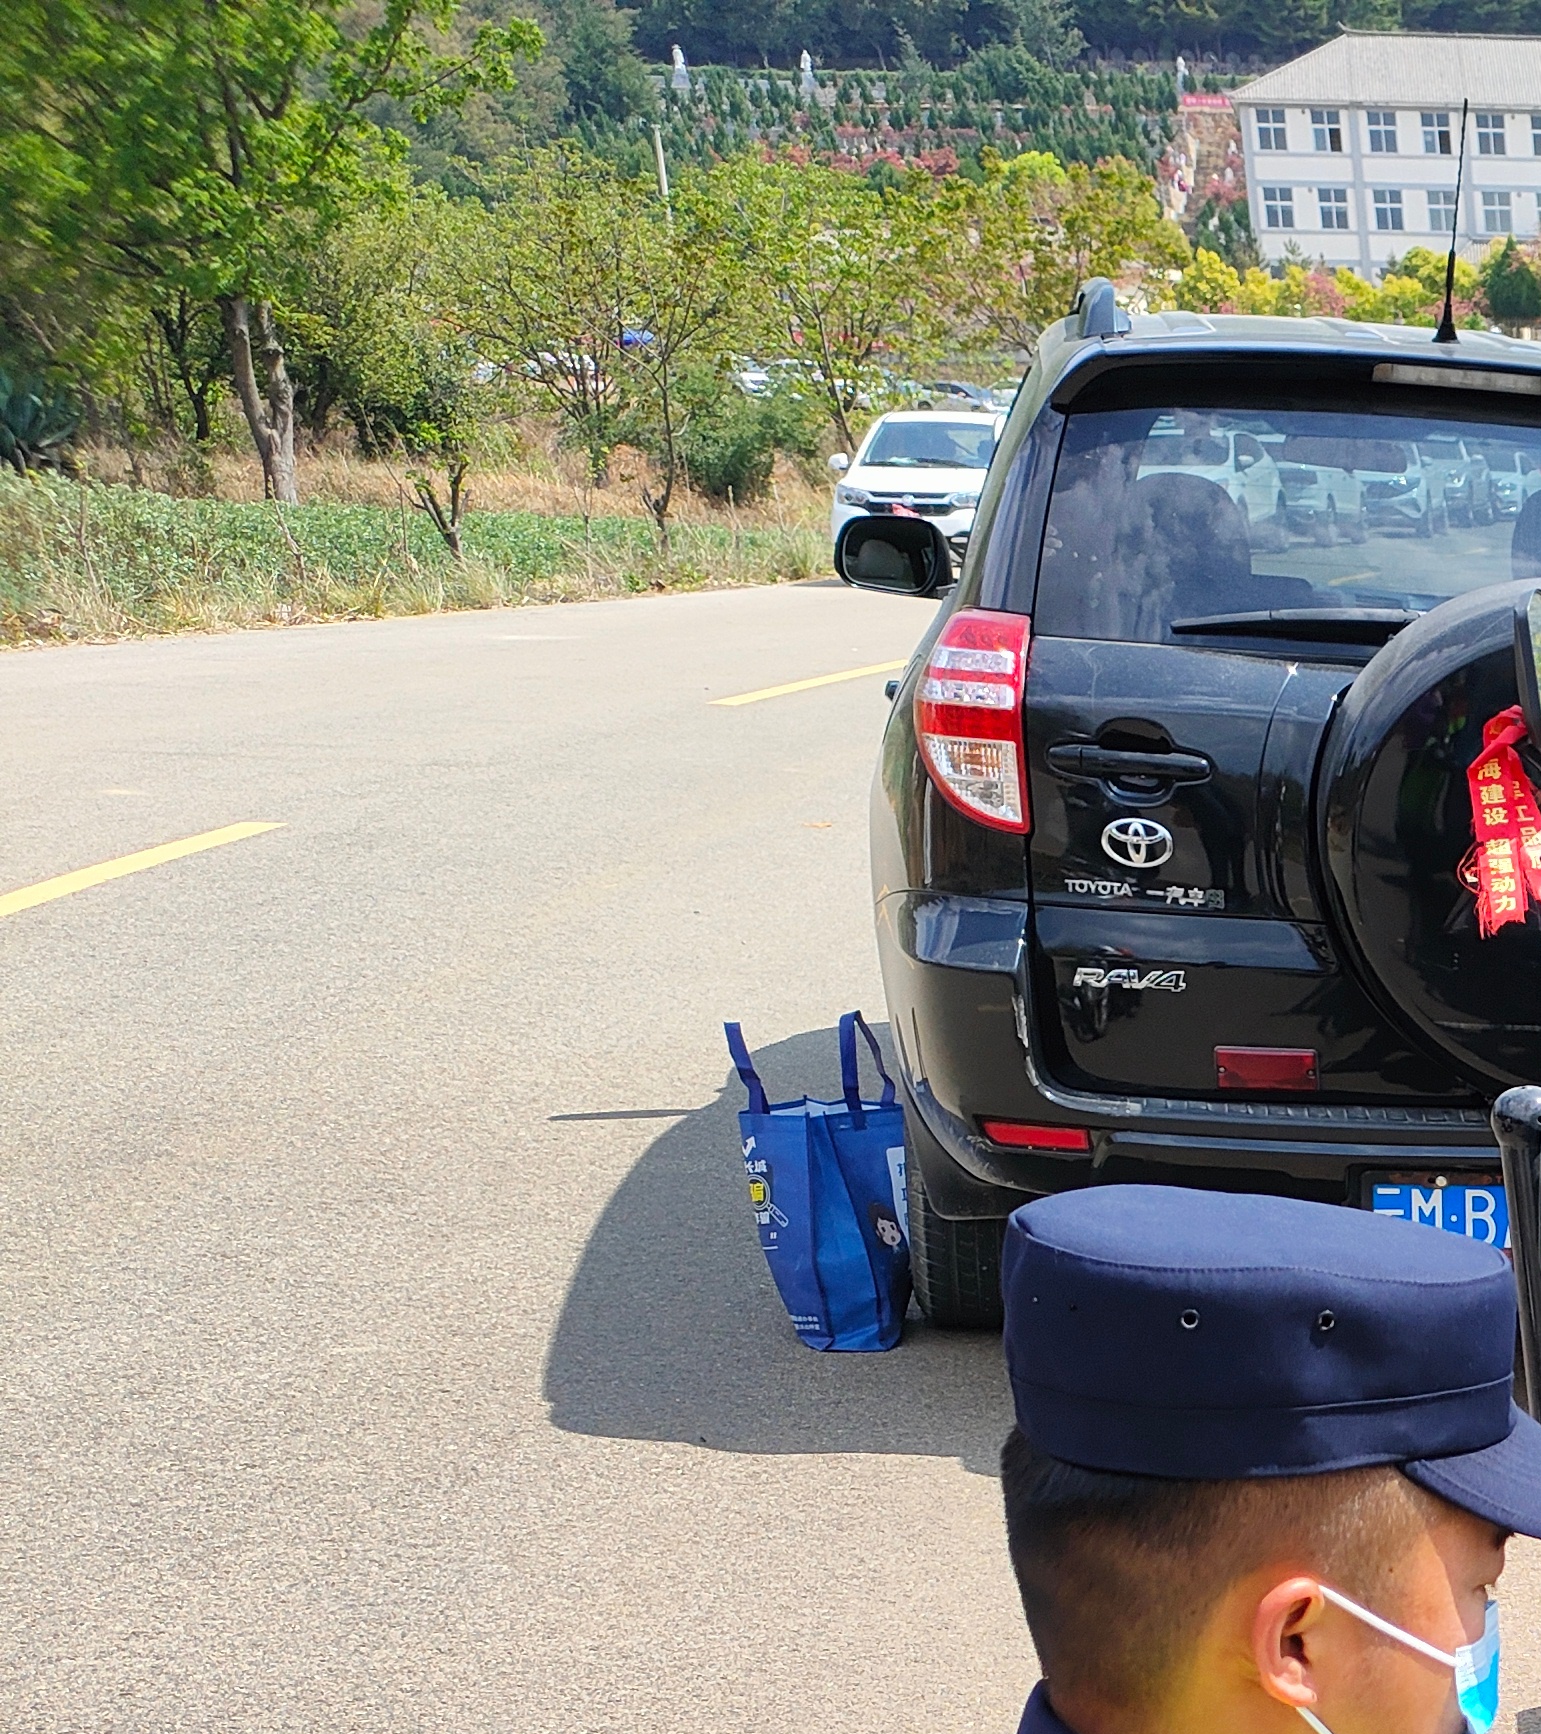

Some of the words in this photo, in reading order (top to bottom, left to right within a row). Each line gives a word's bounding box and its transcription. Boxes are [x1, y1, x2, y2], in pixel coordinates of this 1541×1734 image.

[1064, 878, 1133, 897] TOYOTA
[1484, 837, 1518, 914] 超强动力
[1072, 966, 1188, 993] RAV4
